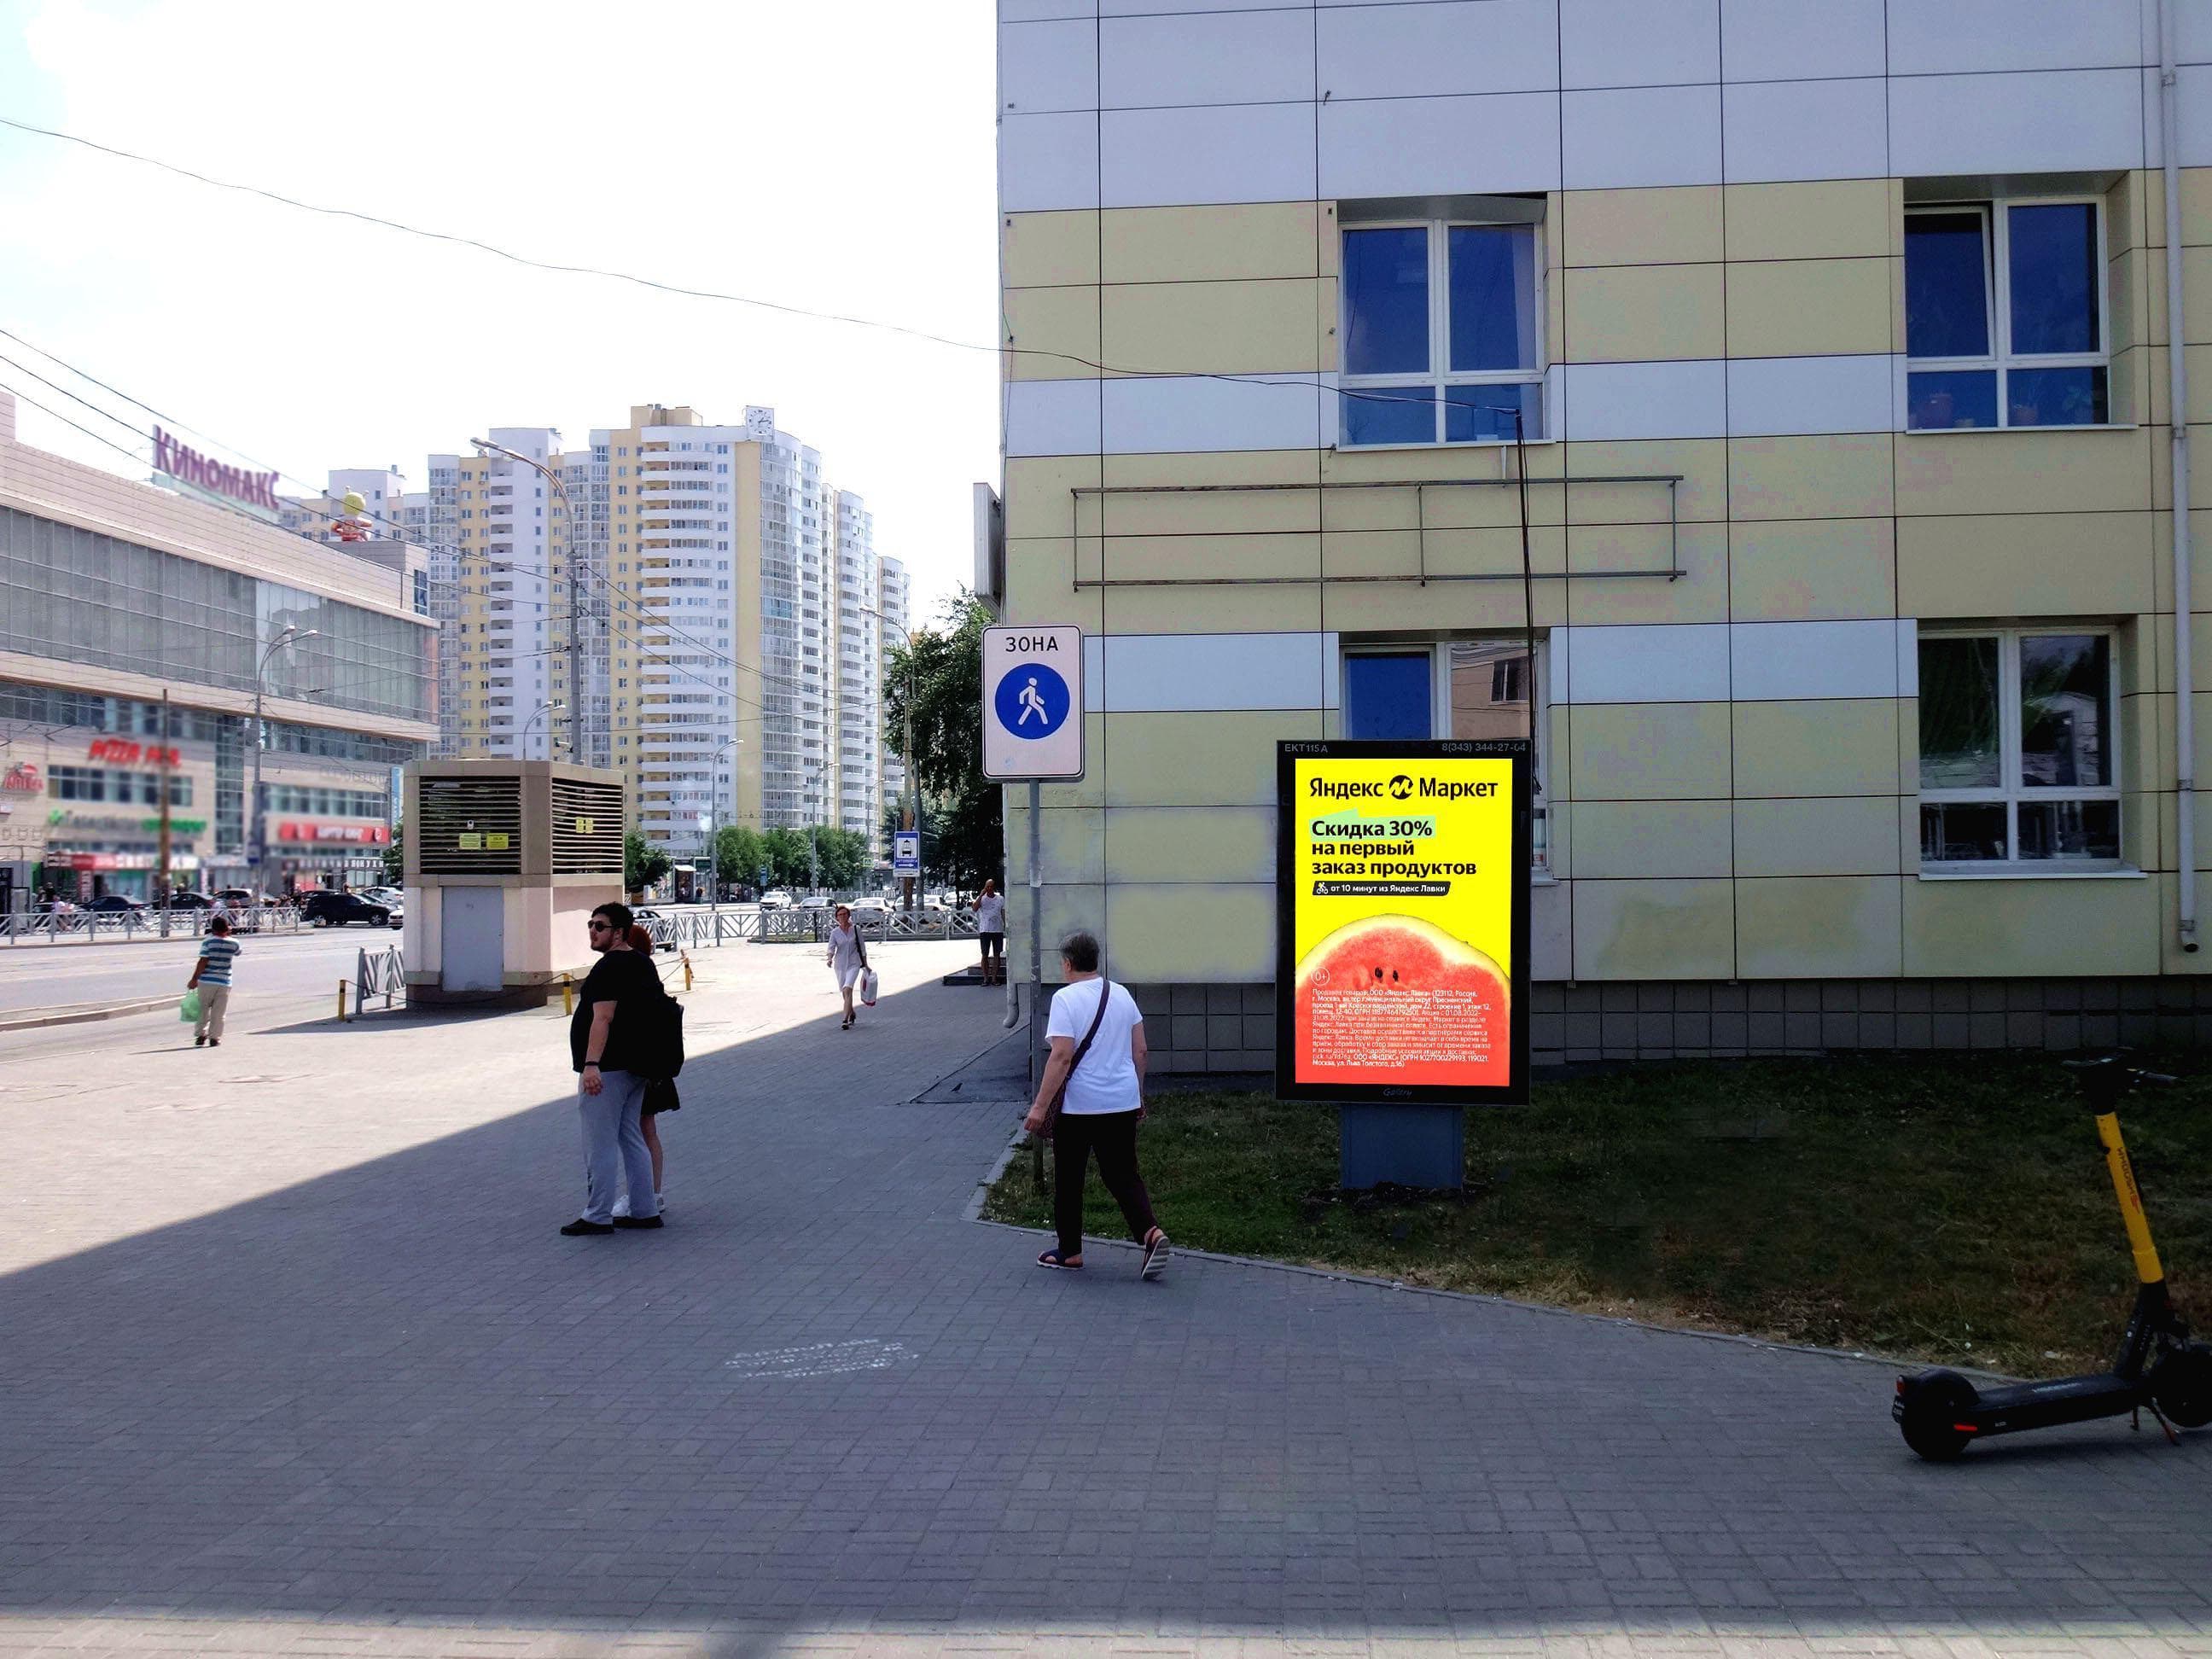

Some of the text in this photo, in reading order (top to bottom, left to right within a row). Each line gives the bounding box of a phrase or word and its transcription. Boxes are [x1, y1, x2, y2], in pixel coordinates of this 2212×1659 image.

[154, 424, 280, 510] КИНОМАКС
[1005, 636, 1059, 652] ЗОНА
[1441, 742, 1526, 753] 8(343) 344-27-04
[1310, 777, 1499, 800] Яндекс Маркет
[1312, 820, 1433, 839] Скидка 30%
[1312, 841, 1414, 859] на первый
[1312, 863, 1476, 878] заказ продуктов
[1390, 885, 1419, 894] Яндекс
[1314, 970, 1327, 981] 0+
